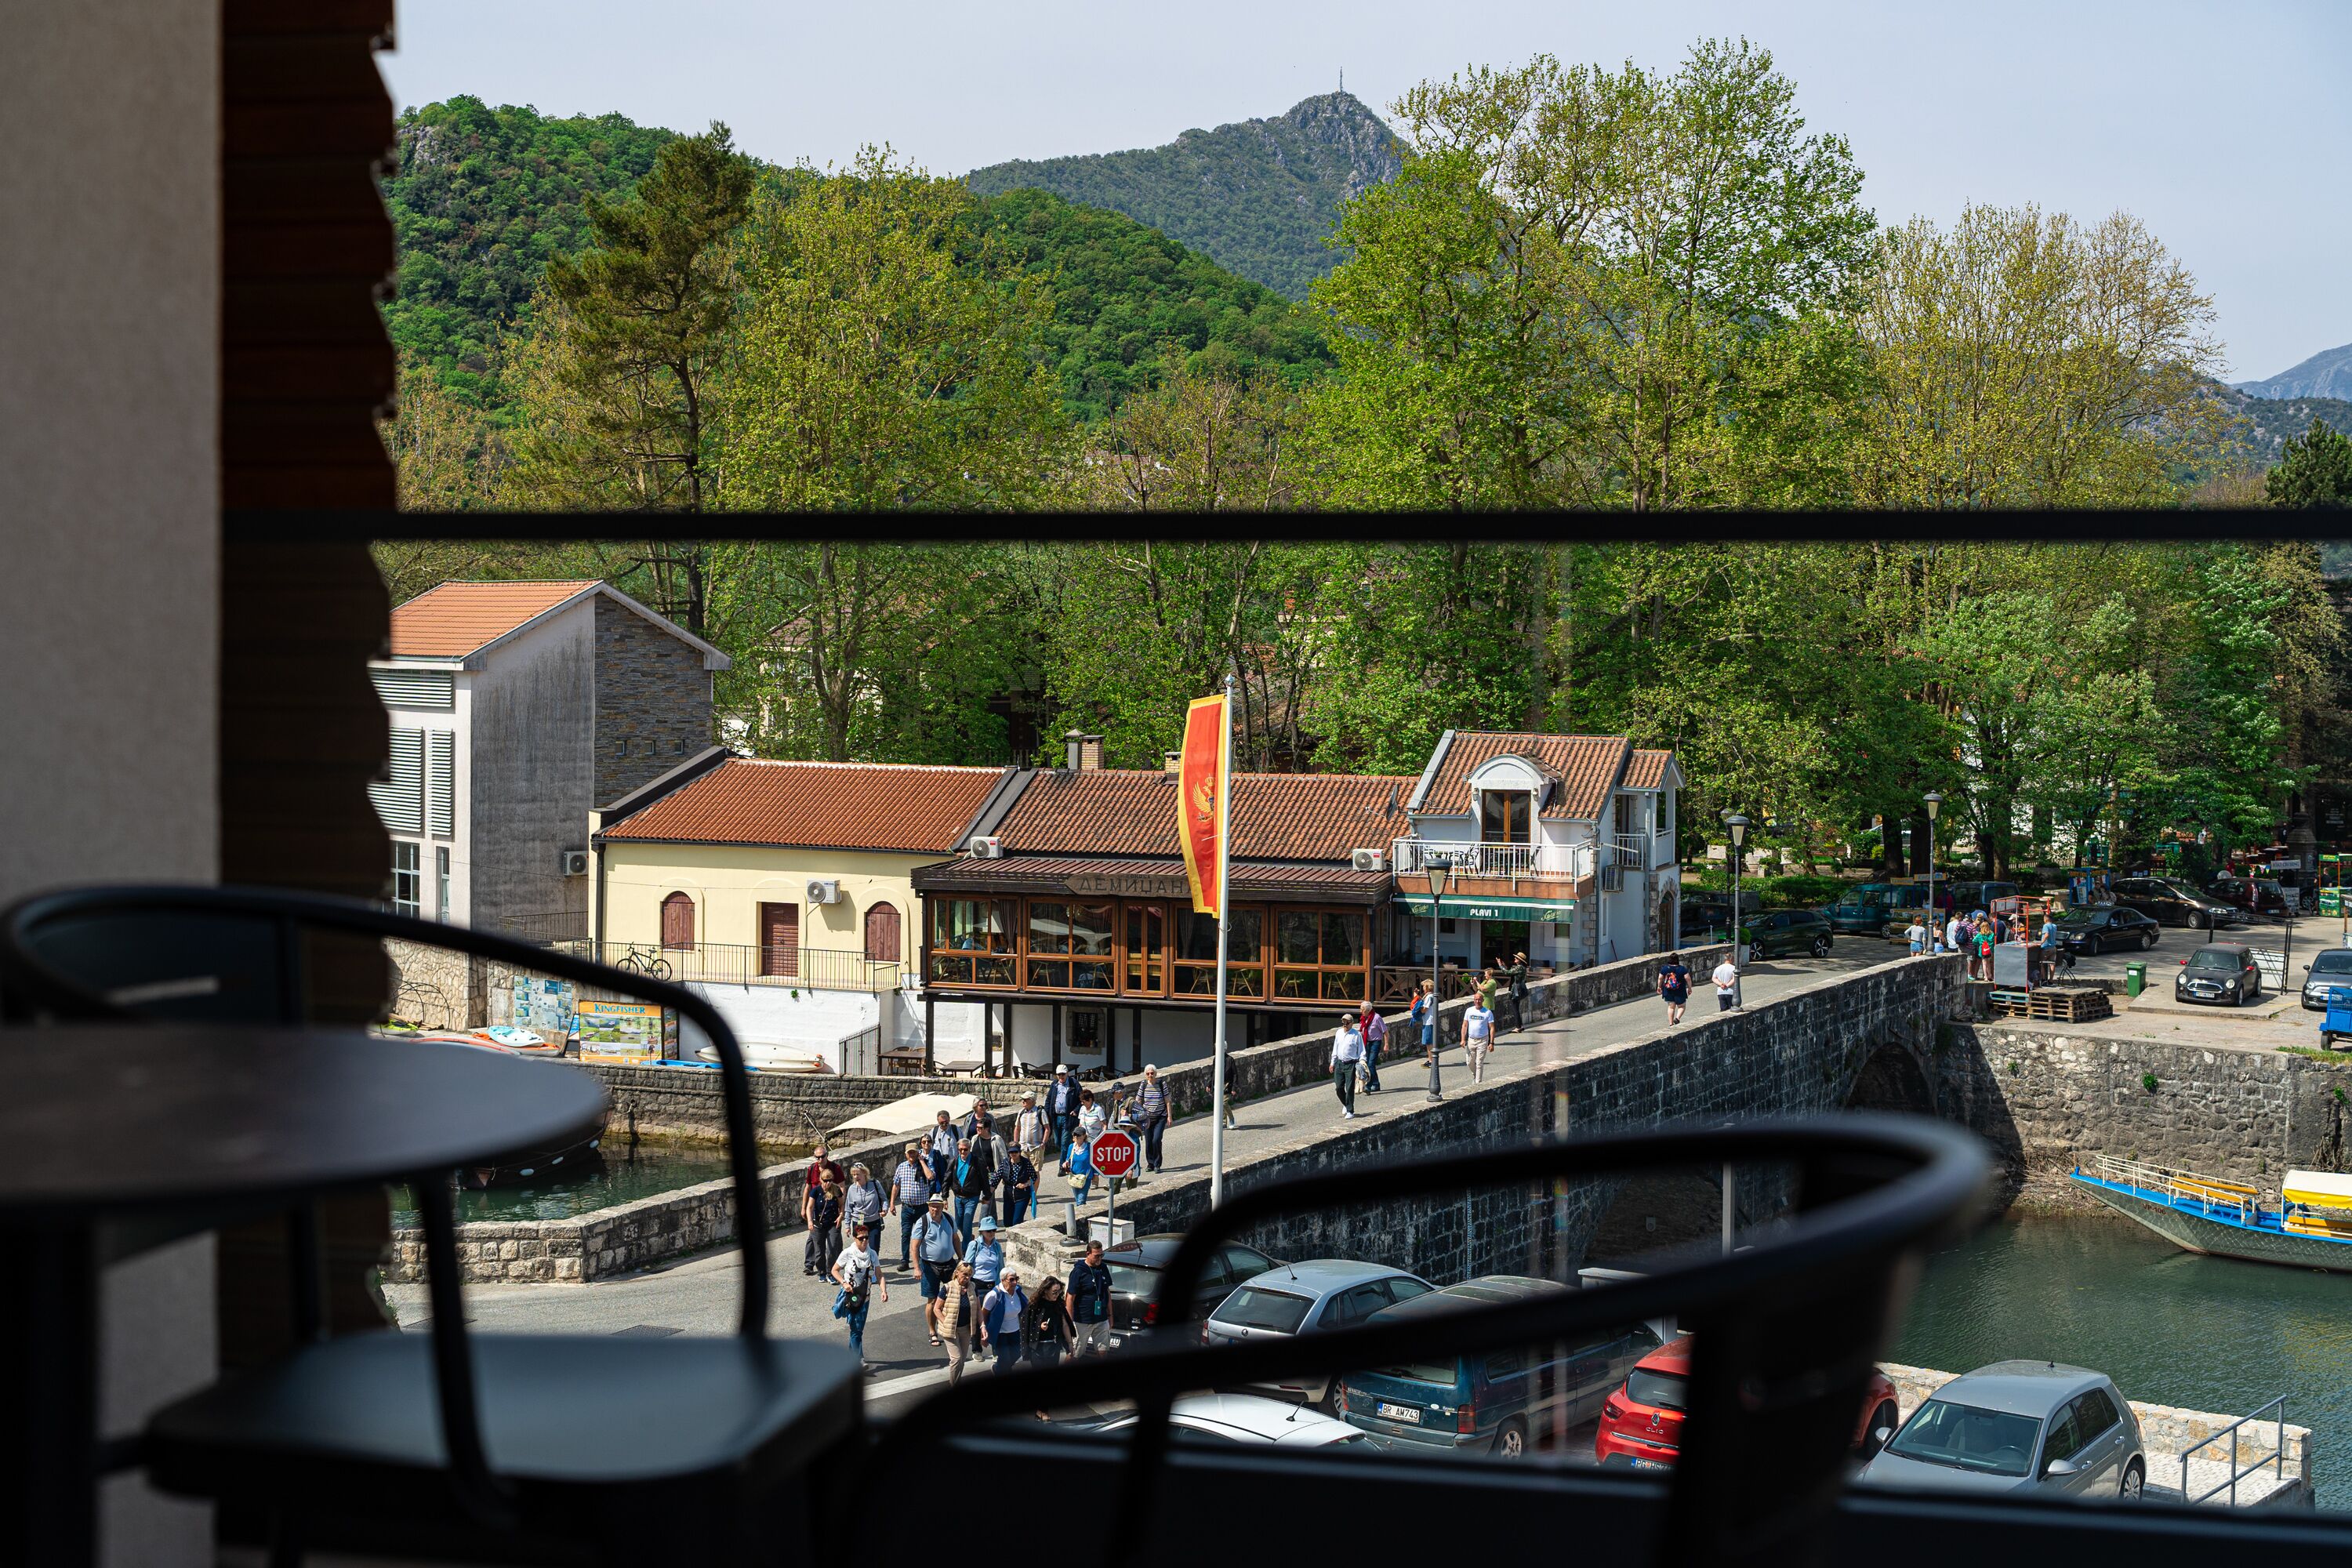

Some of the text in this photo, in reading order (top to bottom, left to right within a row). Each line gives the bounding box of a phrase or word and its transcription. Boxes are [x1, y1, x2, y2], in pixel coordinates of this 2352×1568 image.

[1469, 908, 1492, 916] PLAVI
[594, 1003, 645, 1014] KINGFISHER
[1096, 1146, 1131, 1162] STOP
[2142, 1203, 2166, 1214] VP-106
[1383, 1404, 1419, 1419] BR AM743
[1636, 1459, 1646, 1468] PG
